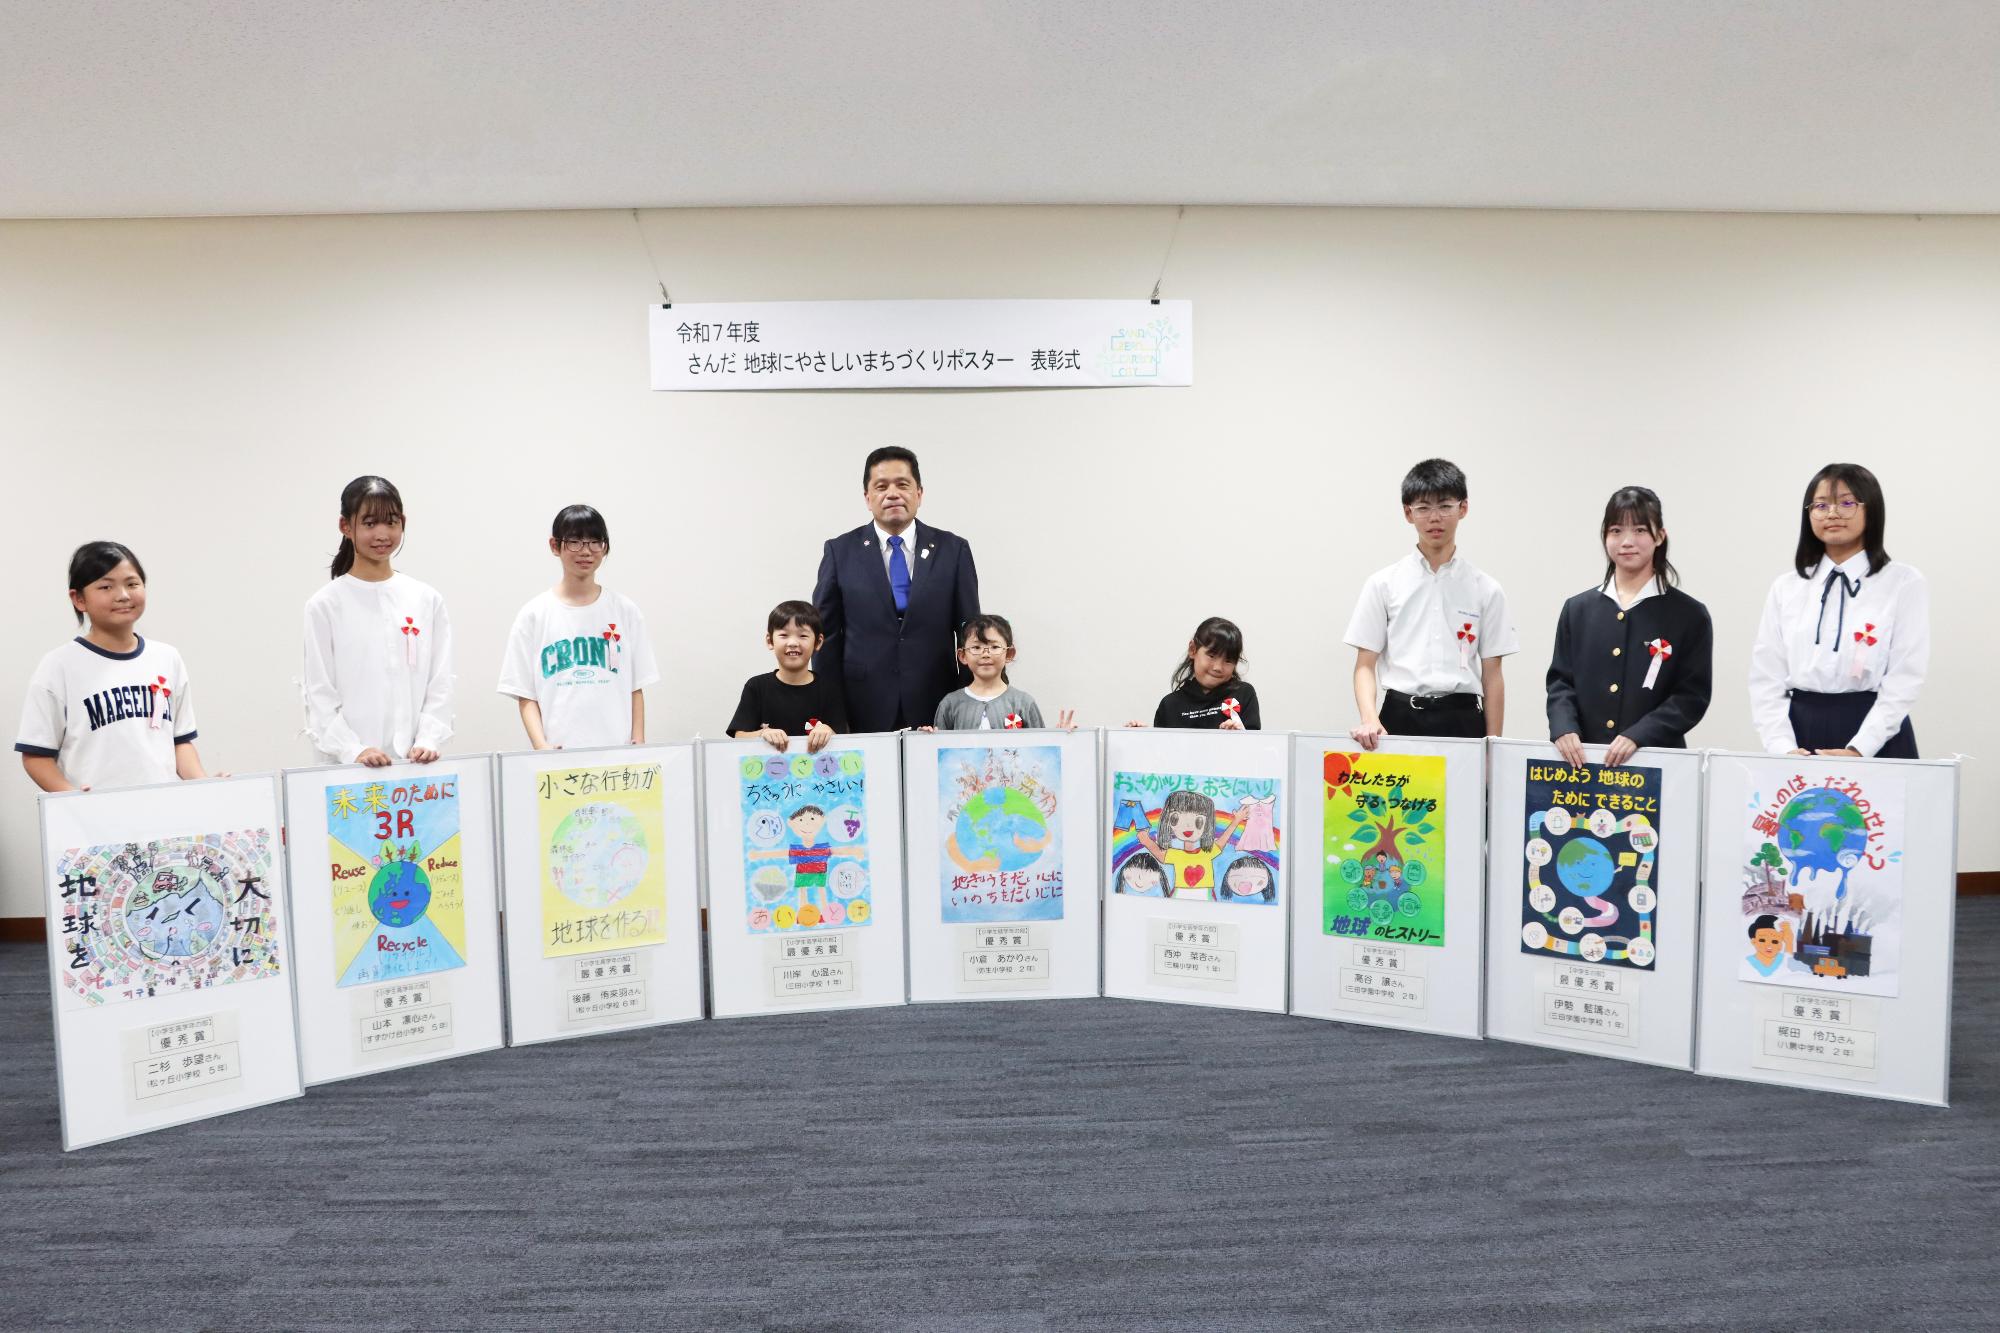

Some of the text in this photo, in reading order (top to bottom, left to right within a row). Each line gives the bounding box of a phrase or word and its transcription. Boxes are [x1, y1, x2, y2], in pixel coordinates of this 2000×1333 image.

[676, 321, 760, 343] 令和7年度
[688, 348, 1081, 374] さんだ 地球にやさしいまちづくりポスター 表彰式
[745, 756, 859, 776] のこさない
[1530, 766, 1645, 788] はじめよう 地球の
[539, 764, 662, 799] 小さな行動が
[1113, 772, 1274, 797] おさがりも おきにいり
[1337, 771, 1411, 787] わたしたちが
[332, 782, 455, 819] 未来のために
[746, 779, 864, 805] ちきゅうに やさしい!
[1552, 789, 1657, 812] ために できること
[374, 809, 415, 840] 3R
[331, 863, 367, 881] Reuse
[427, 856, 458, 872] Reduce
[59, 873, 100, 969] 地球を
[230, 869, 271, 967] 大切に
[377, 934, 428, 952] Recycle
[997, 953, 1039, 964] あかりさん
[1793, 1005, 1841, 1021] 優秀賞
[372, 1018, 393, 1031] 山本
